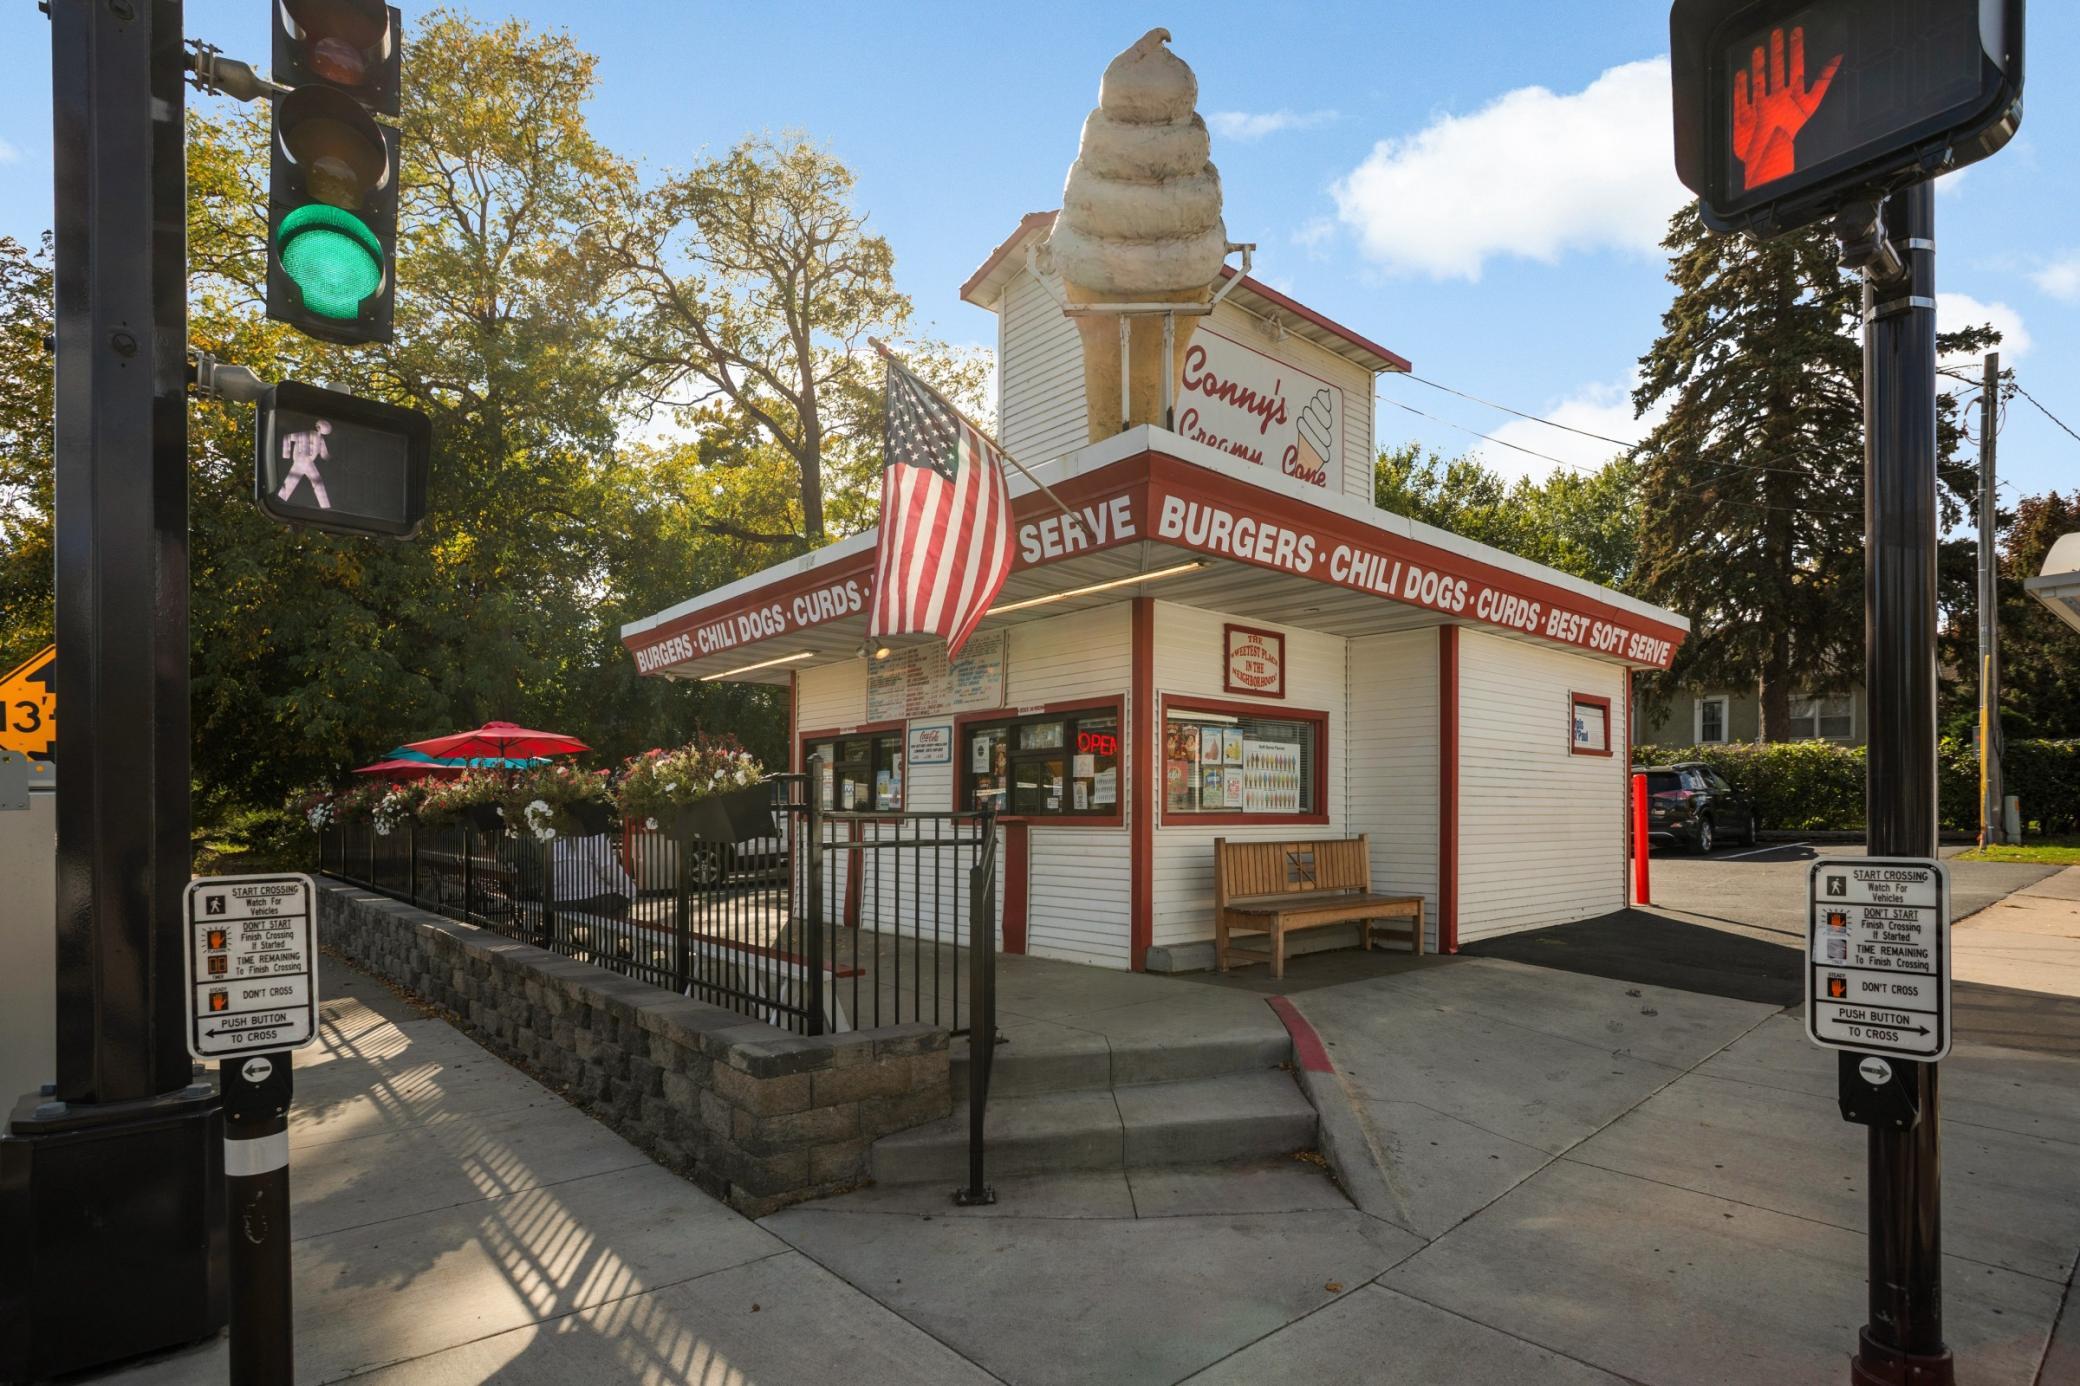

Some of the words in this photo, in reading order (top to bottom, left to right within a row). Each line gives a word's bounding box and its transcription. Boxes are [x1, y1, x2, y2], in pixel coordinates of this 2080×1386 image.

[1182, 345, 1287, 435] Conny's
[1282, 444, 1326, 487] Cone
[636, 633, 694, 673] BURGERS
[698, 620, 737, 653] CHILI
[738, 604, 786, 642] DOGS
[793, 581, 862, 626] CURDS
[1019, 494, 1136, 564] SERVE
[1158, 495, 1316, 573] BURGERS
[1330, 545, 1401, 595] CHILI
[1404, 566, 1467, 612] DOGS
[1476, 588, 1540, 631] CURDS
[1546, 608, 1590, 643] BEST
[1589, 621, 1629, 654] SOFT
[1628, 633, 1671, 665] SERVE
[1248, 635, 1263, 645] THE
[1077, 732, 1118, 756] OPEN
[1853, 870, 1881, 879] START
[1884, 871, 1928, 880] CROSSING
[232, 887, 257, 896] START
[260, 885, 298, 895] CROSSING
[1868, 883, 1890, 892] Watch
[1896, 884, 1907, 892] For
[246, 898, 266, 906] Watch
[271, 897, 282, 905] For
[1873, 893, 1904, 902] Vehicles
[250, 907, 278, 916] Vehicles
[1864, 908, 1888, 918] DON'T
[1894, 909, 1918, 920] START
[243, 920, 266, 930] DON'T
[270, 919, 291, 929] START
[1861, 920, 1884, 929] Finish
[1888, 922, 1921, 934] Crossing
[241, 932, 262, 941] Finish
[266, 931, 294, 941] Crossing
[1883, 931, 1910, 941] Started
[261, 940, 285, 949] Started
[1856, 944, 1876, 954] TIME
[1881, 946, 1928, 958] REMAINING
[237, 956, 255, 965] TIME
[259, 952, 300, 963] REMAINING
[1855, 955, 1864, 964] To
[1869, 956, 1891, 967] Finish
[1896, 959, 1929, 972] Crossing
[236, 967, 244, 975] To
[249, 965, 269, 974] Finish
[274, 963, 301, 972] Crossing
[243, 988, 266, 999] DON'T
[270, 986, 293, 997] CROSS
[1862, 982, 1887, 993] DON'T
[1892, 985, 1918, 996] CROSS
[222, 1017, 247, 1028] PUSH
[252, 1013, 287, 1025] BUTTON
[1839, 1008, 1865, 1020] PUSH
[1871, 1012, 1910, 1025] BUTTON
[232, 1034, 242, 1043] TO
[248, 1030, 278, 1042] CROSS
[1849, 1026, 1860, 1037] TO
[1866, 1029, 1899, 1041] CROSS
